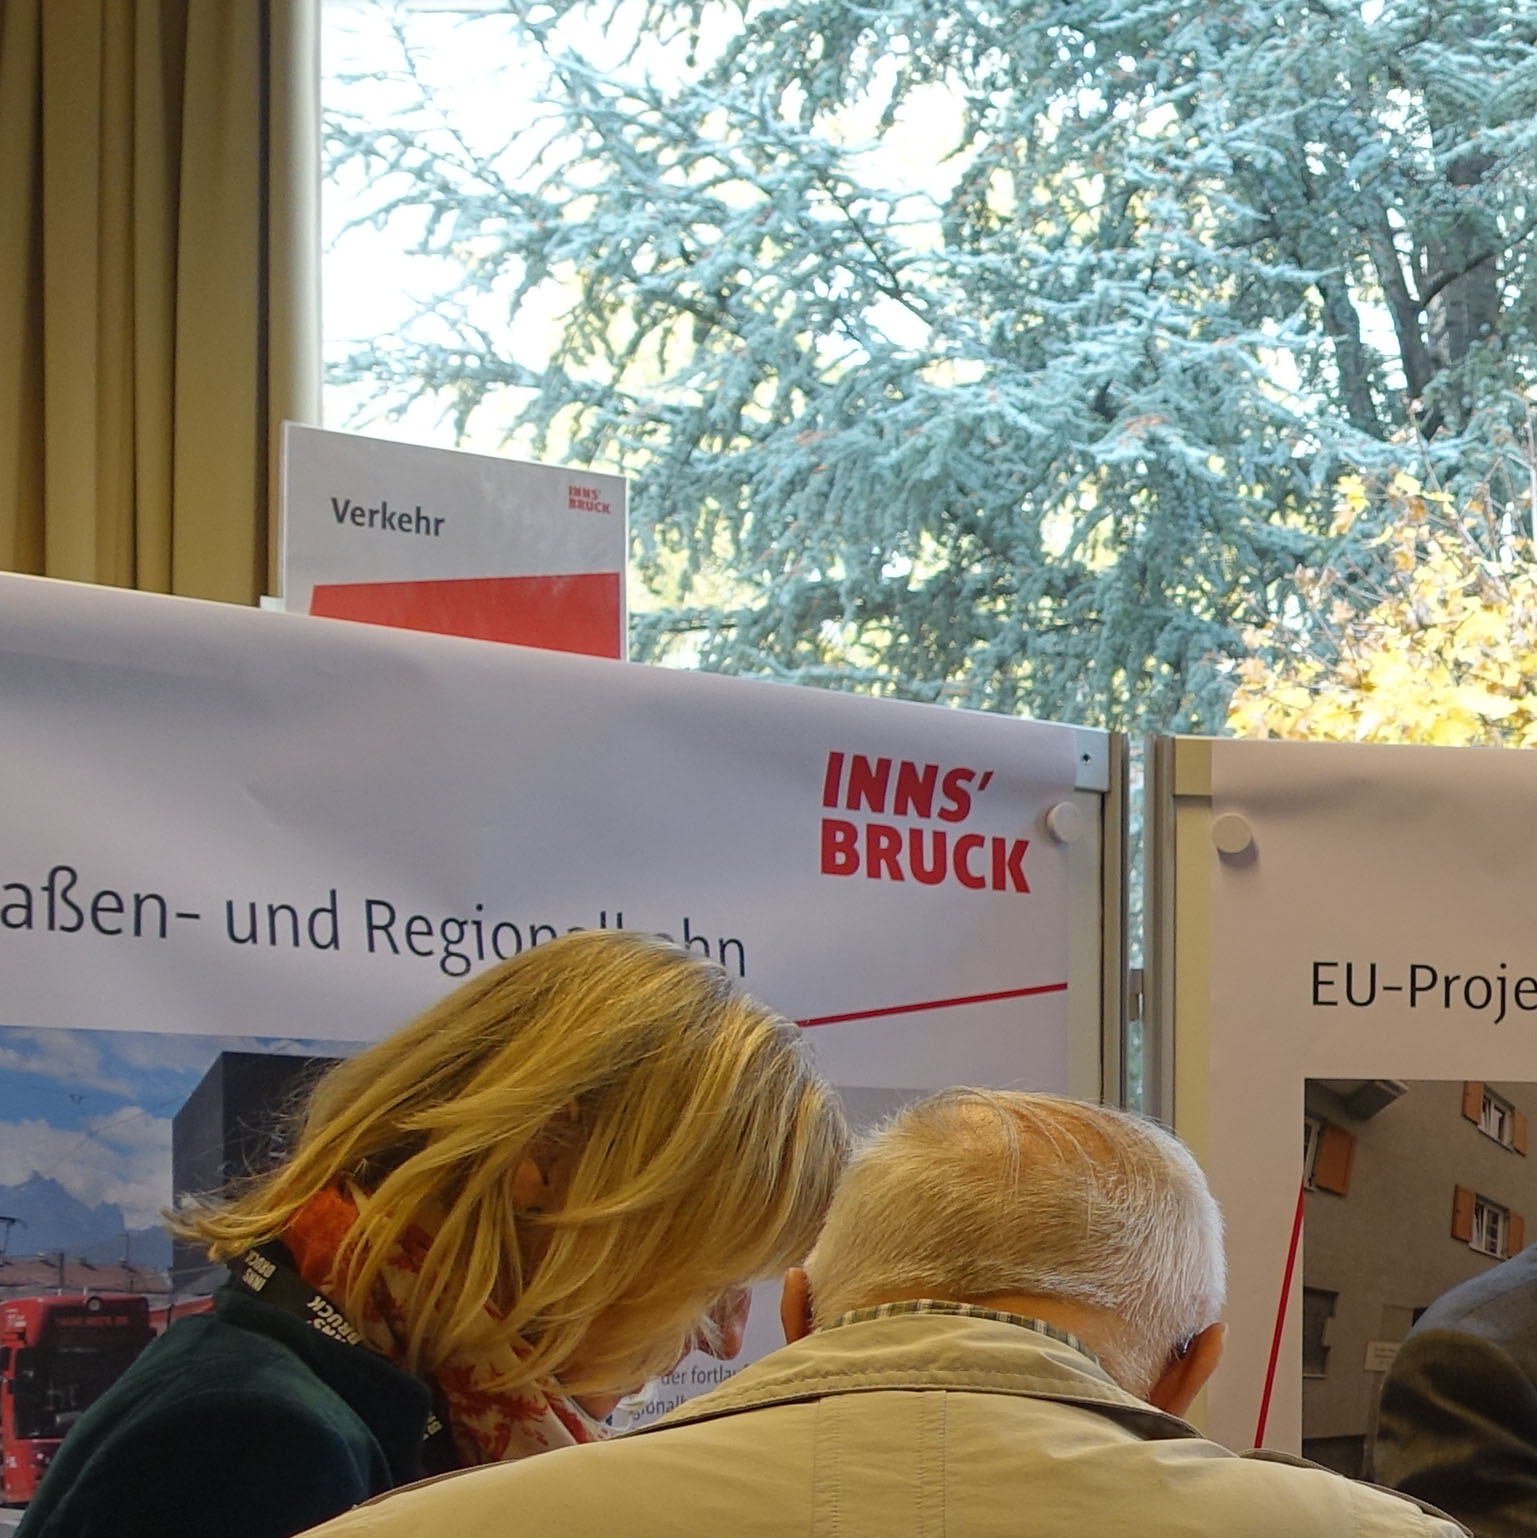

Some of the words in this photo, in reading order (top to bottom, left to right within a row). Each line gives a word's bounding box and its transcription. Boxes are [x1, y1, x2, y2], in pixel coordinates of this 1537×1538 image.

[331, 497, 445, 537] Verkehr
[569, 498, 611, 514] BRUCK
[823, 751, 994, 823] INNS'
[821, 818, 1031, 893] BRUCK
[0, 865, 201, 939] aßen-
[225, 889, 341, 951] und
[367, 897, 746, 977] Regionhn
